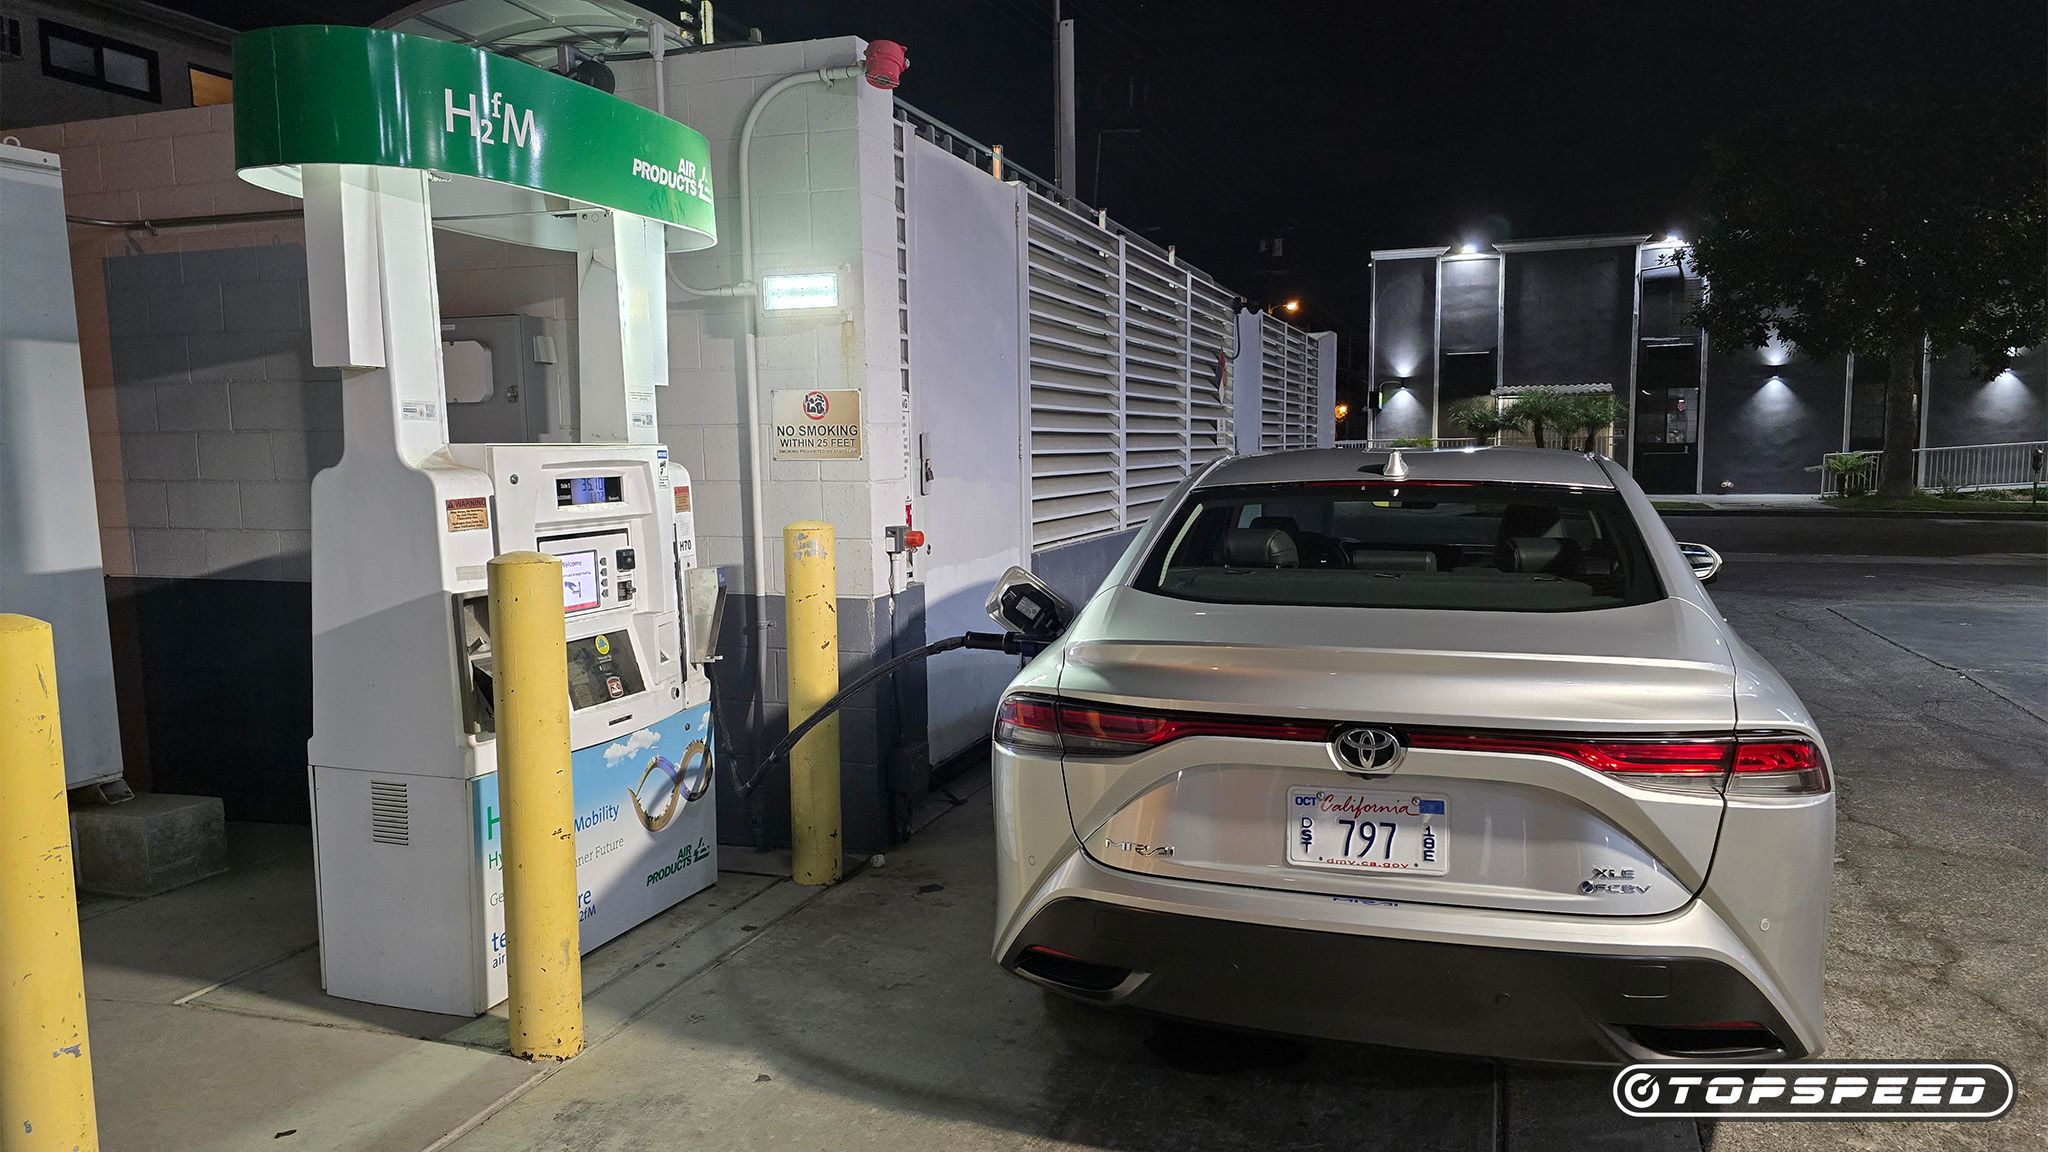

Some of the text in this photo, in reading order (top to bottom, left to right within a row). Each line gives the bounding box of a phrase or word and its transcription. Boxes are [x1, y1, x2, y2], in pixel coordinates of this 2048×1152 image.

[678, 158, 696, 178] AIR
[632, 158, 697, 196] PRODUCTS
[777, 425, 858, 437] NO SMOKING
[780, 438, 856, 447] WITHIN 25 FEET
[455, 497, 487, 508] WARNING
[679, 539, 692, 552] H70
[1295, 796, 1317, 806] OCT
[1320, 794, 1420, 819] California
[574, 804, 620, 832] Mobility
[594, 837, 624, 859] Future
[1338, 819, 1397, 860] 797
[677, 844, 692, 861] AIR
[646, 855, 692, 887] PRODUCTS
[1326, 858, 1409, 869] dmv.ca.gov
[1591, 868, 1635, 880] XLE
